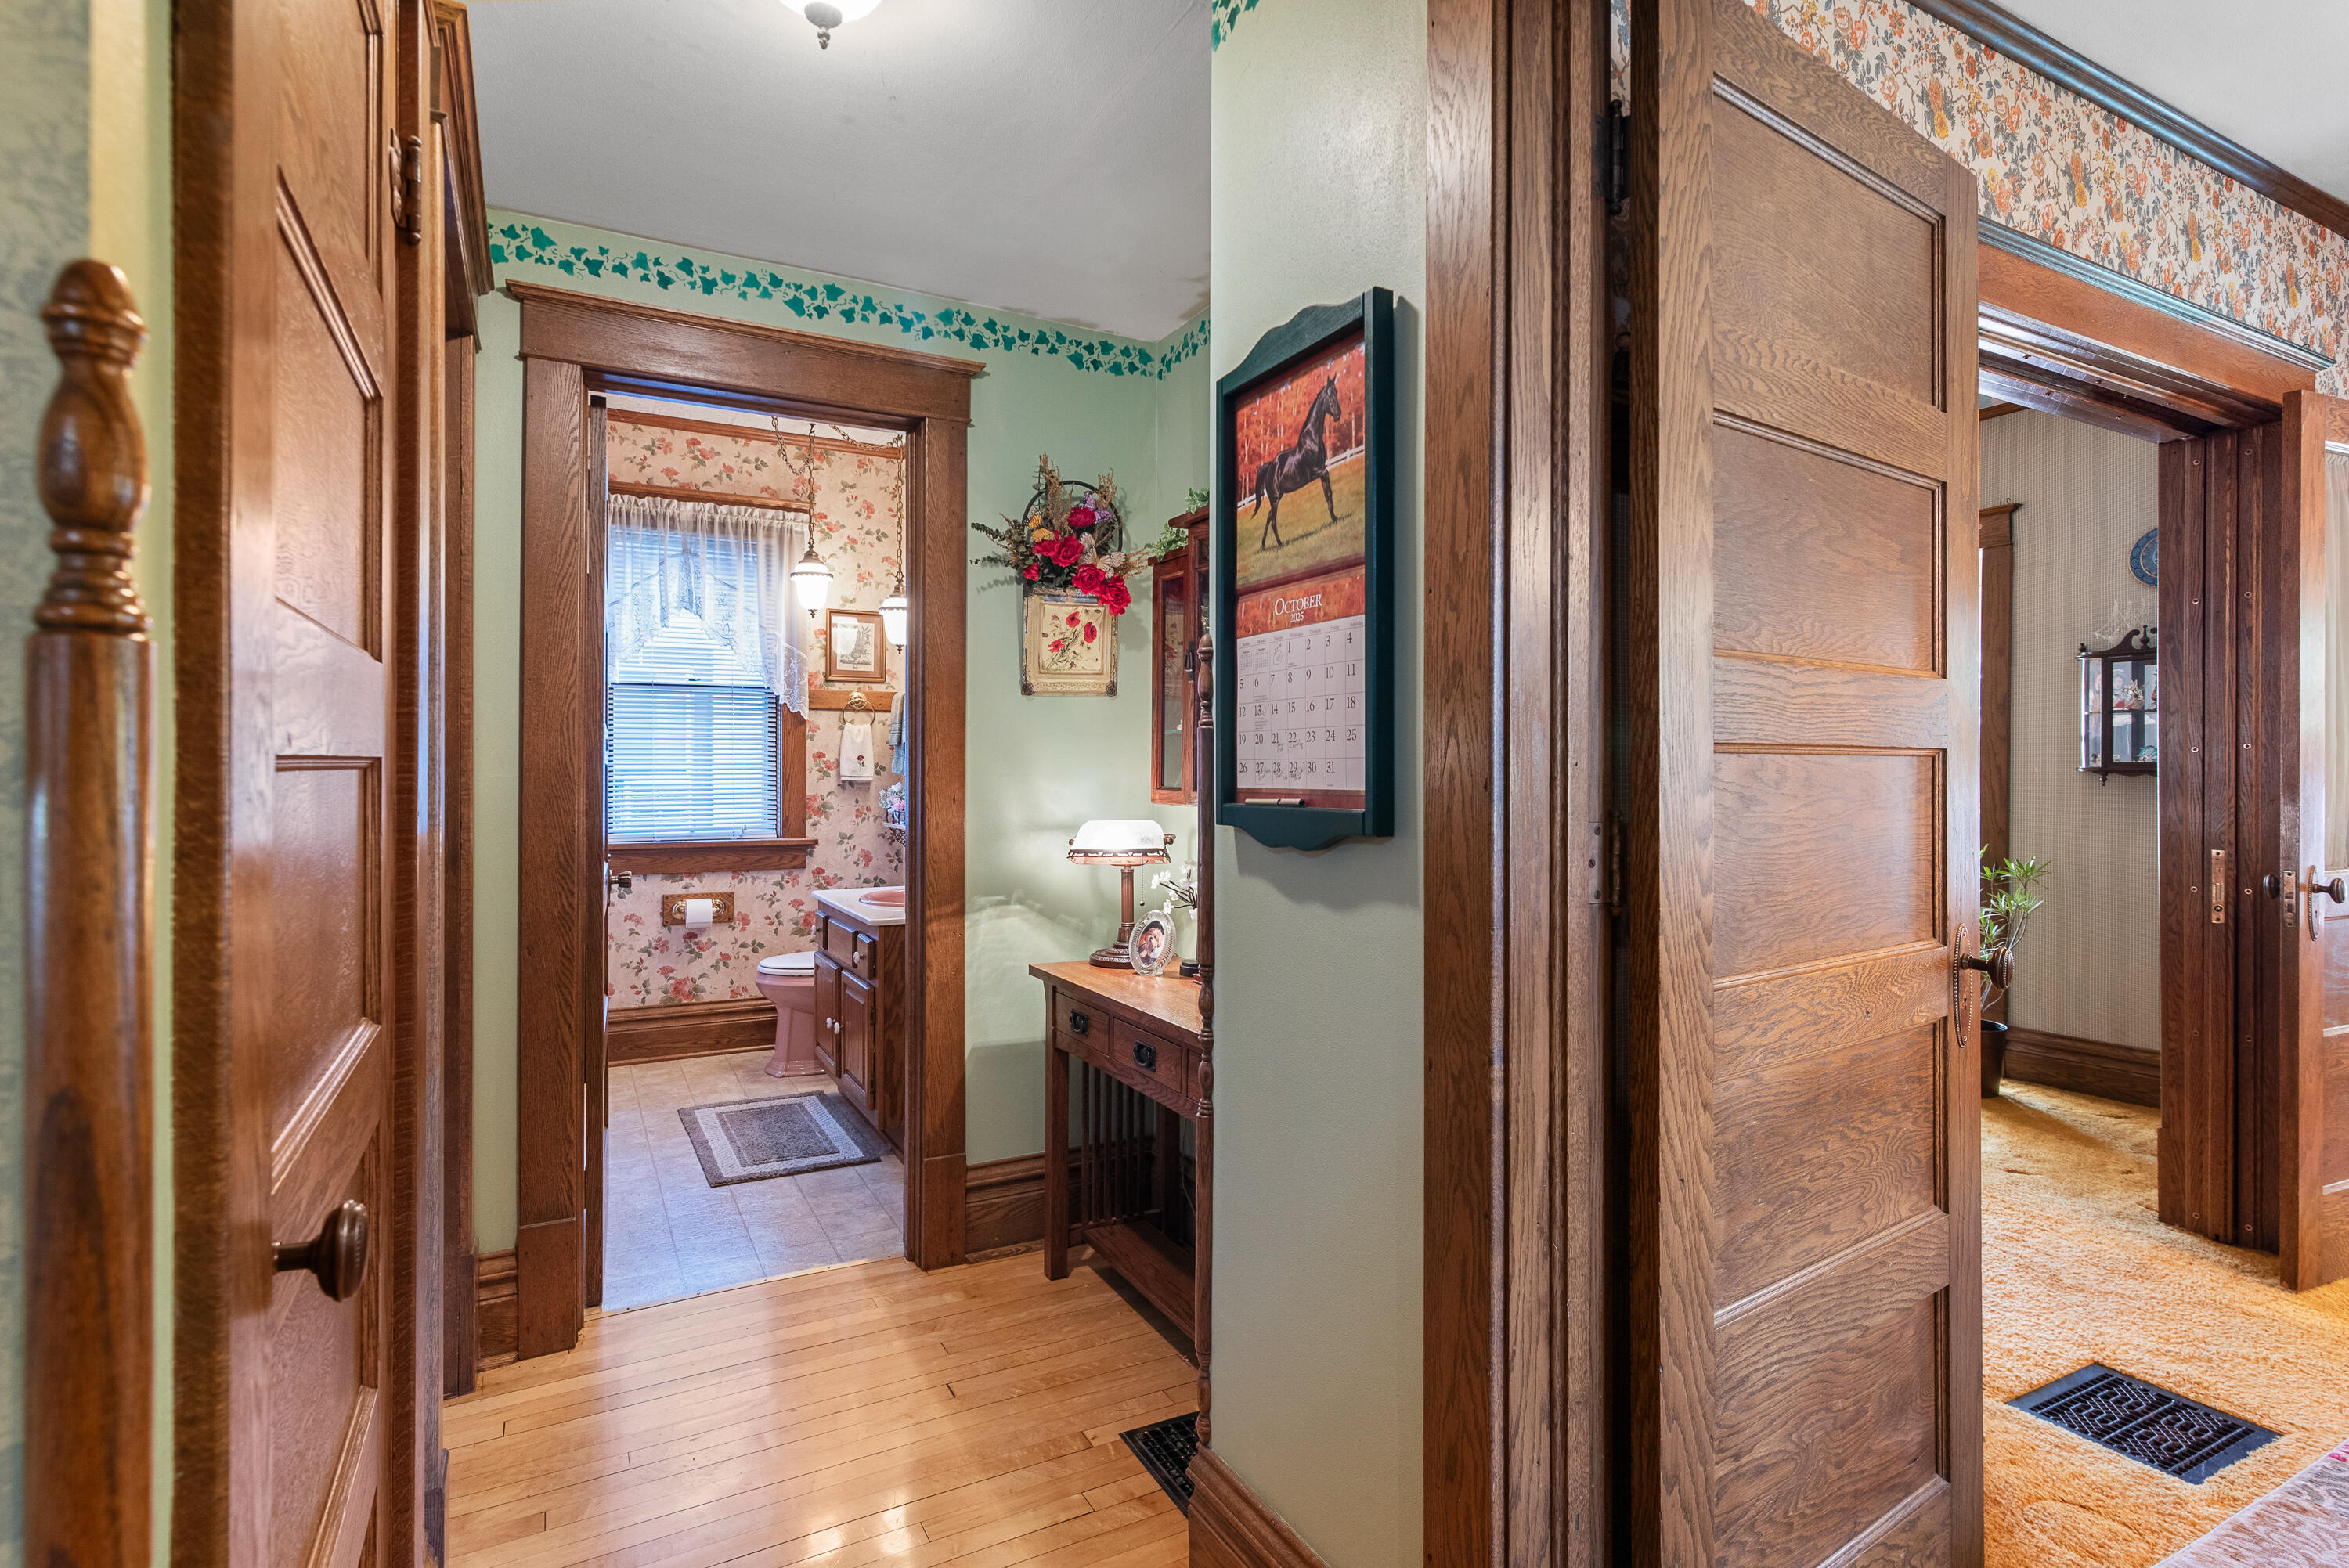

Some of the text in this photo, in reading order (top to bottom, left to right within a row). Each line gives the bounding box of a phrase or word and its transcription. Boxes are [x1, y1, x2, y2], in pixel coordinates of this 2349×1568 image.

[1290, 611, 1304, 623] 2025
[1288, 631, 1353, 653] 1 2 3 4
[1239, 663, 1355, 689] 5 6 7 8 9 10 11
[1239, 696, 1356, 717] 12 13 14 15 16 17 18
[1239, 729, 1357, 745] 19 20 21 22 23 24 25
[1239, 761, 1335, 773] 26 27 28 29 30 31
